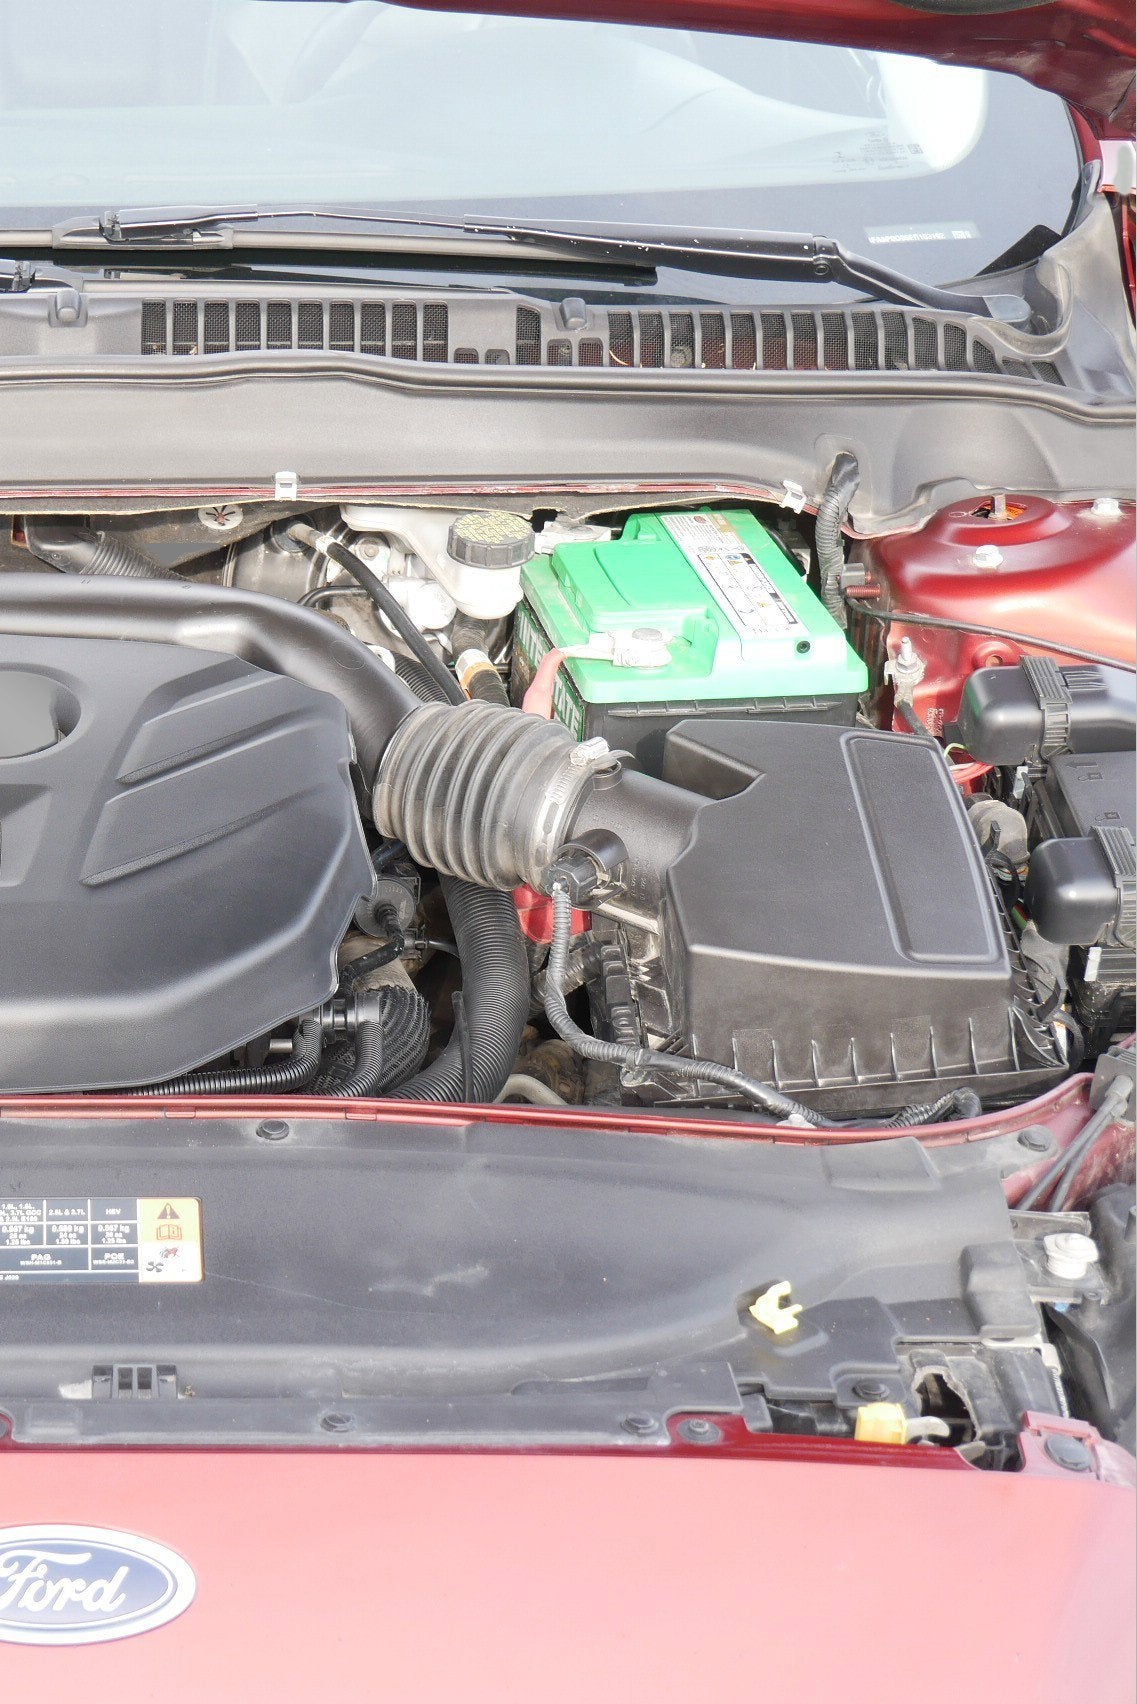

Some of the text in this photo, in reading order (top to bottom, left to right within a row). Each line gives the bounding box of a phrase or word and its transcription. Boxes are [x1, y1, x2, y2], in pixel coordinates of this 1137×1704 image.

[24, 1225, 34, 1234] kg
[74, 1225, 84, 1233] kg
[120, 1224, 130, 1233] kg
